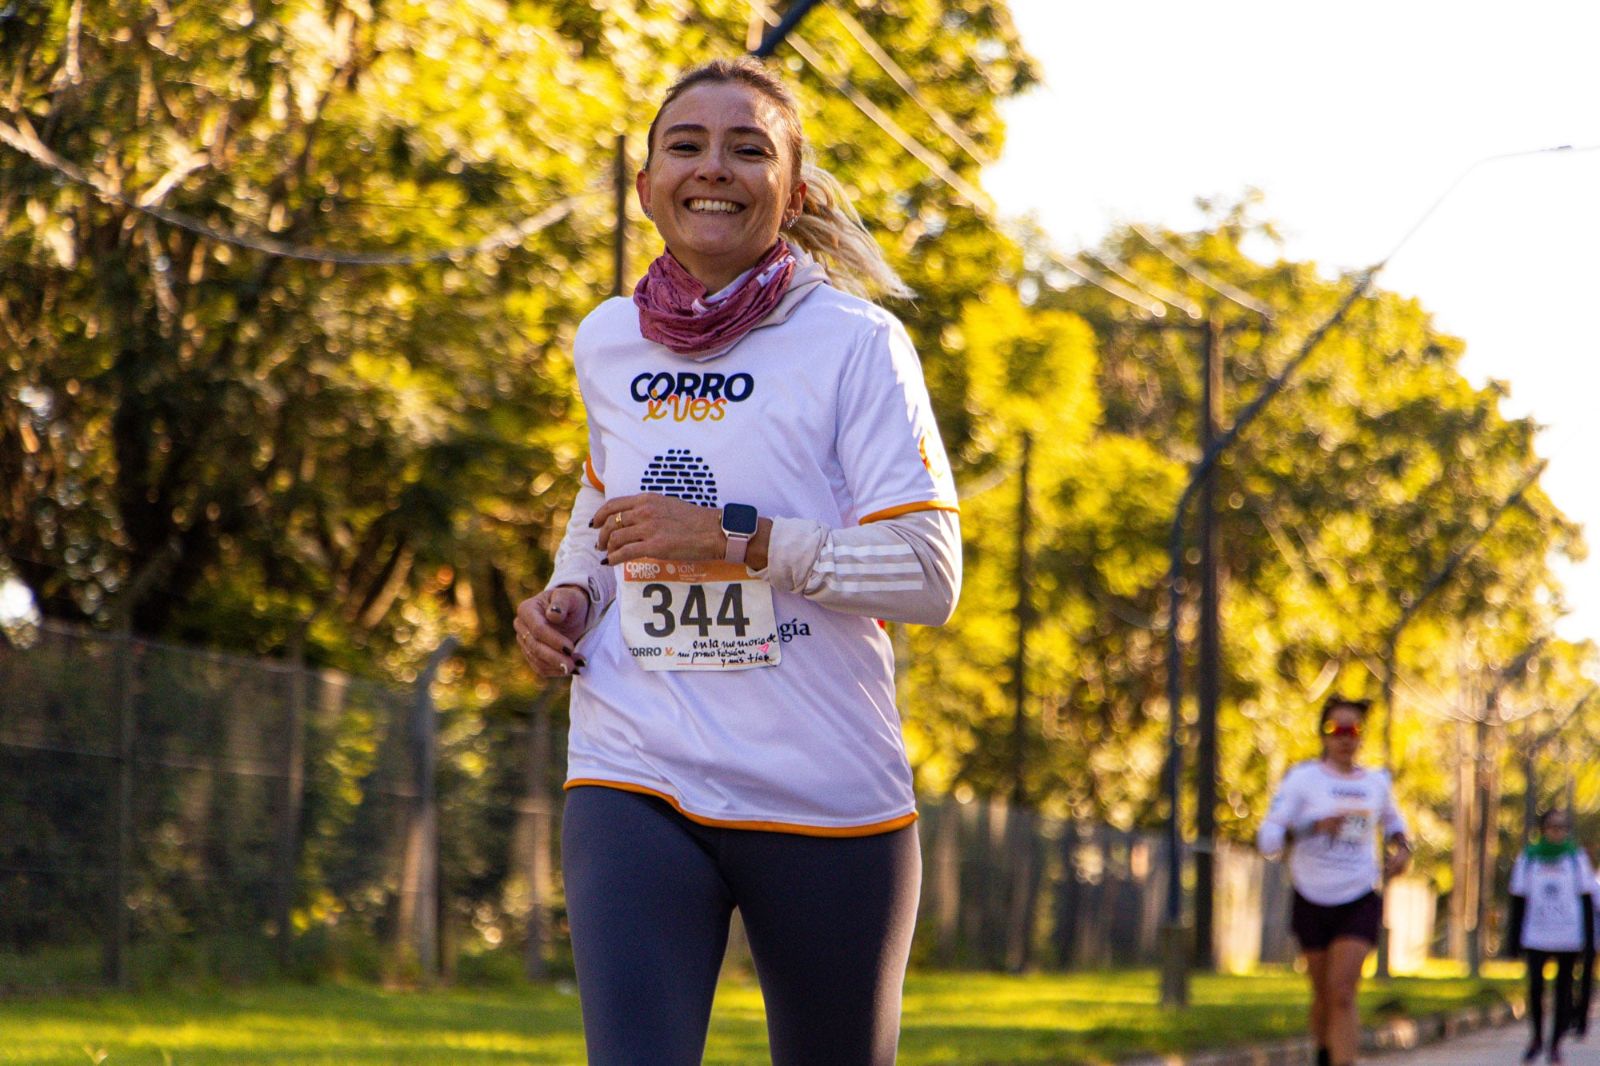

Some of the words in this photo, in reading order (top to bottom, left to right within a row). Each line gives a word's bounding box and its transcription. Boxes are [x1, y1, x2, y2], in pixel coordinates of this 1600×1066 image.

[631, 372, 754, 402] CORRO
[625, 561, 660, 574] CORRO
[642, 583, 750, 638] 344
[777, 618, 812, 643] gía
